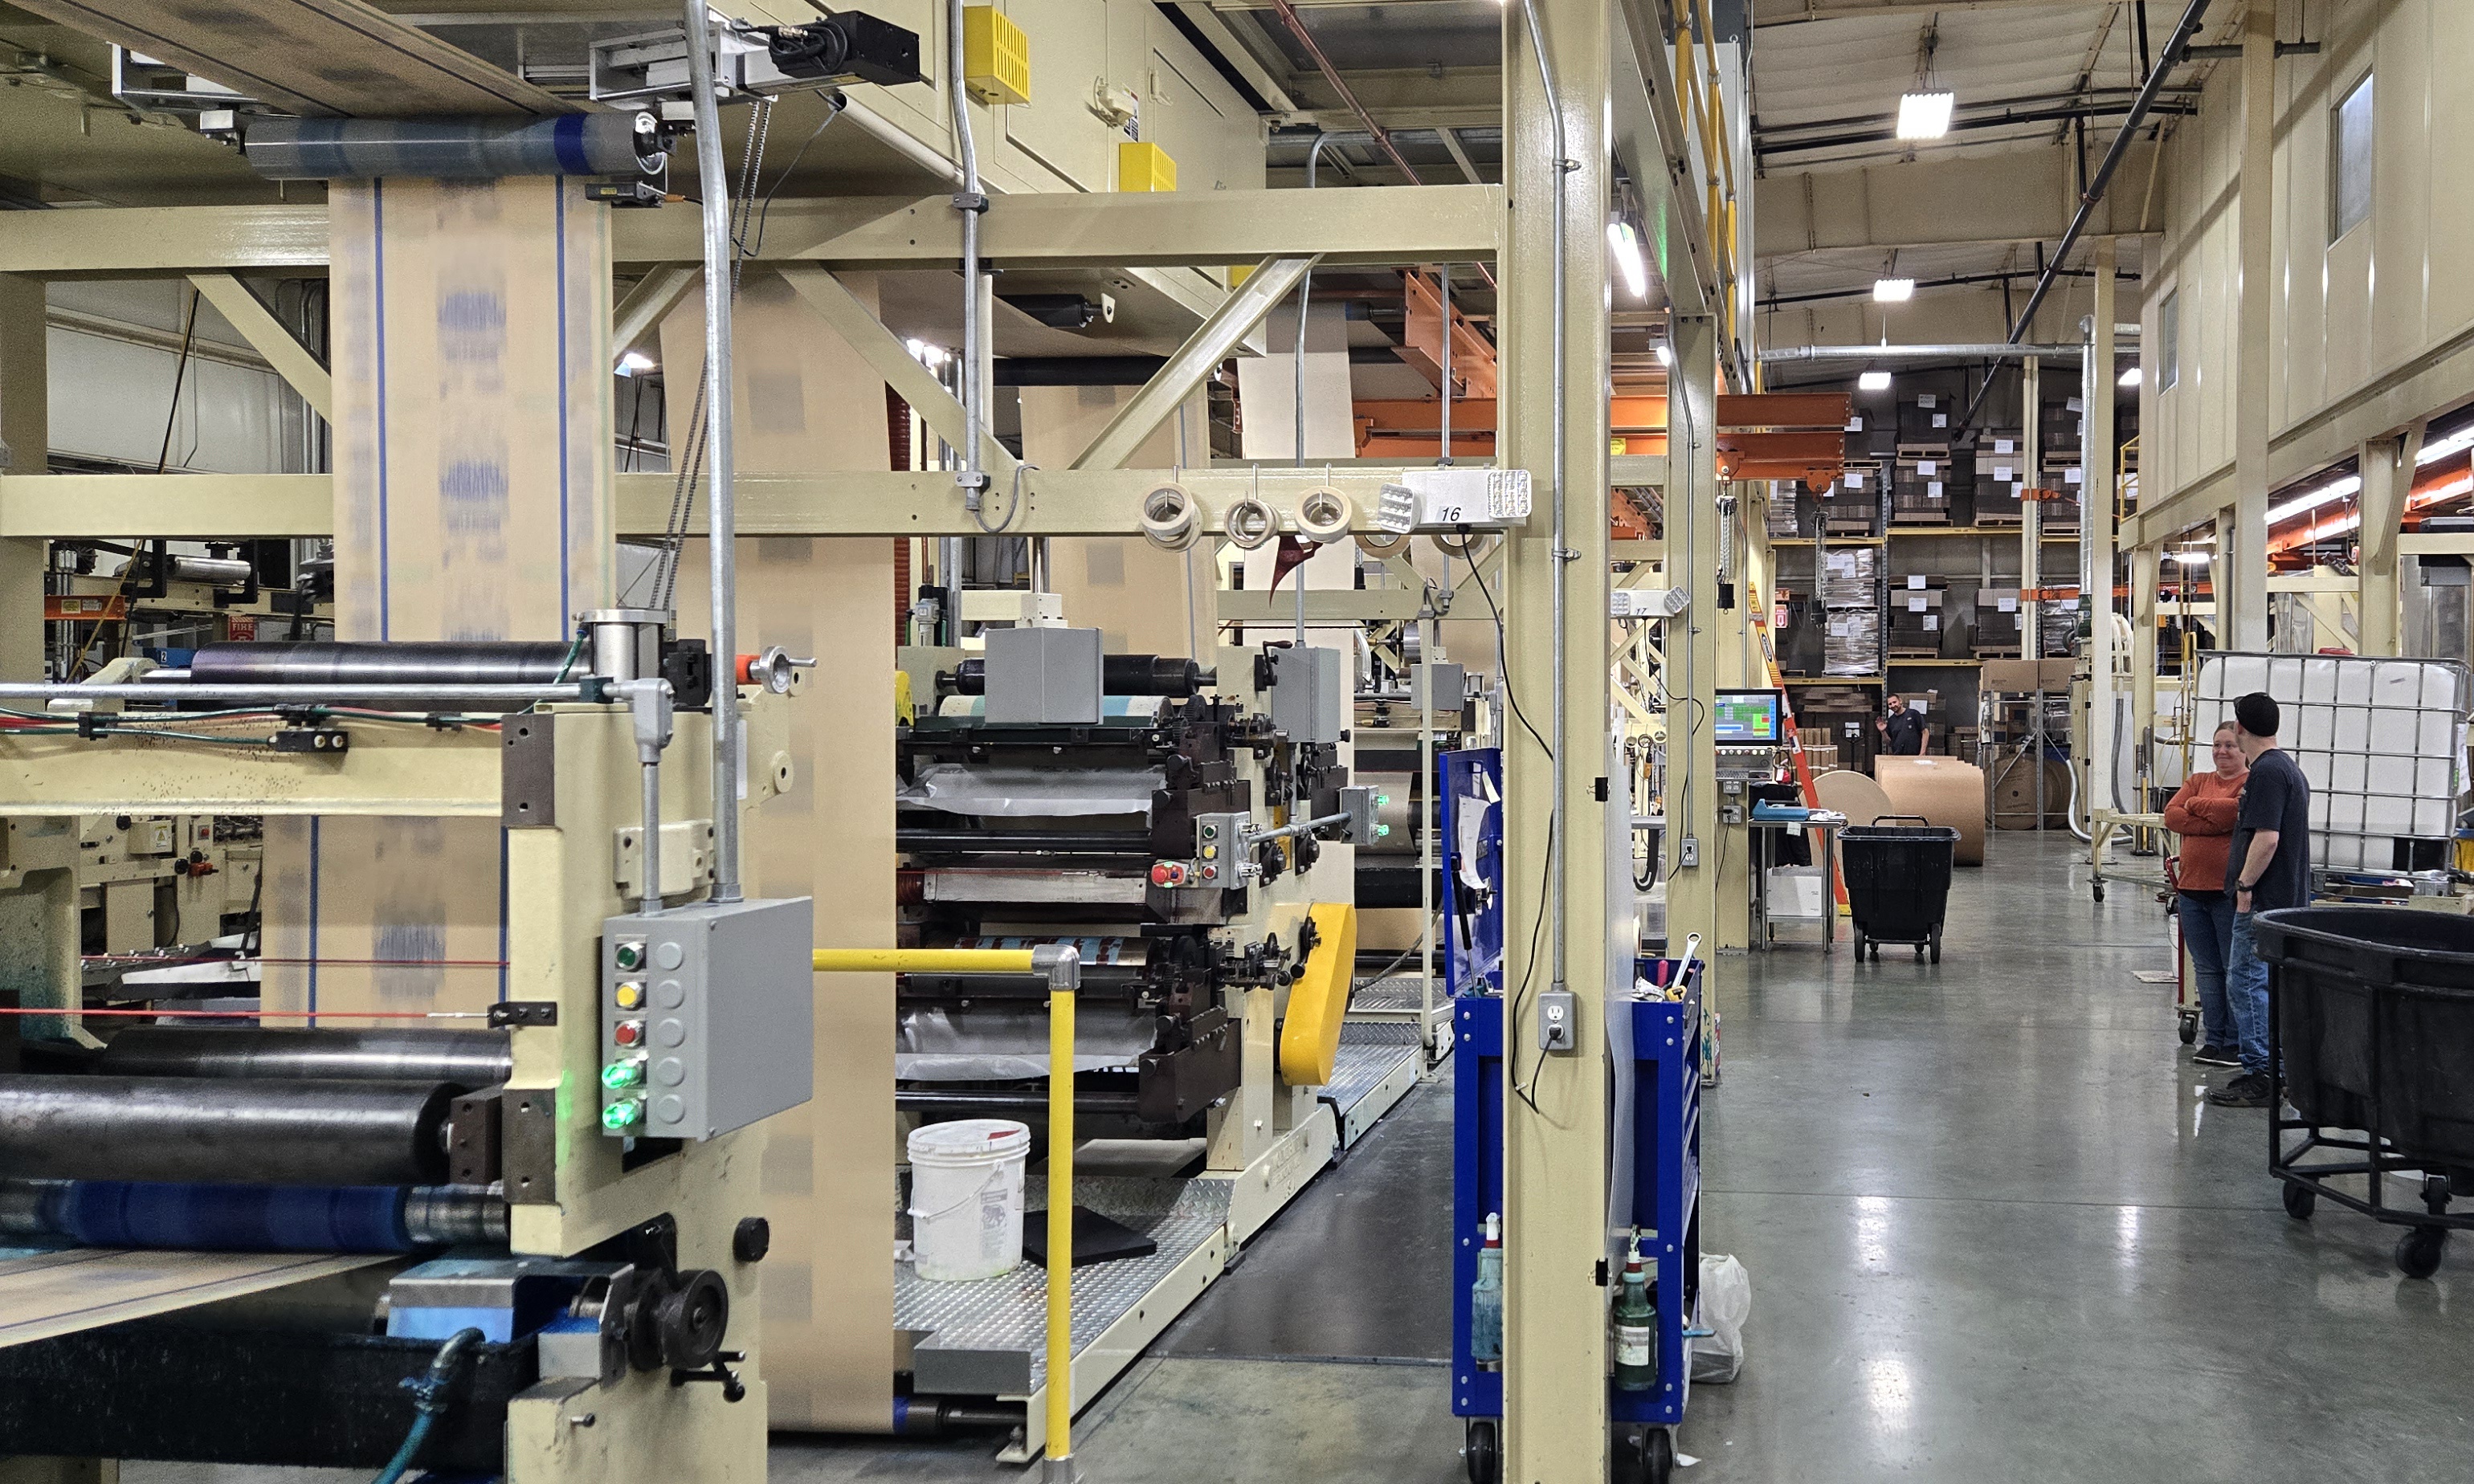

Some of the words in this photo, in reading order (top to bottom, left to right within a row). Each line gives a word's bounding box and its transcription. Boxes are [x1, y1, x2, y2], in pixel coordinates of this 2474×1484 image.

[1443, 507, 1461, 522] 16
[1636, 607, 1647, 615] 17
[232, 622, 254, 631] FIRE
[161, 651, 166, 662] 2
